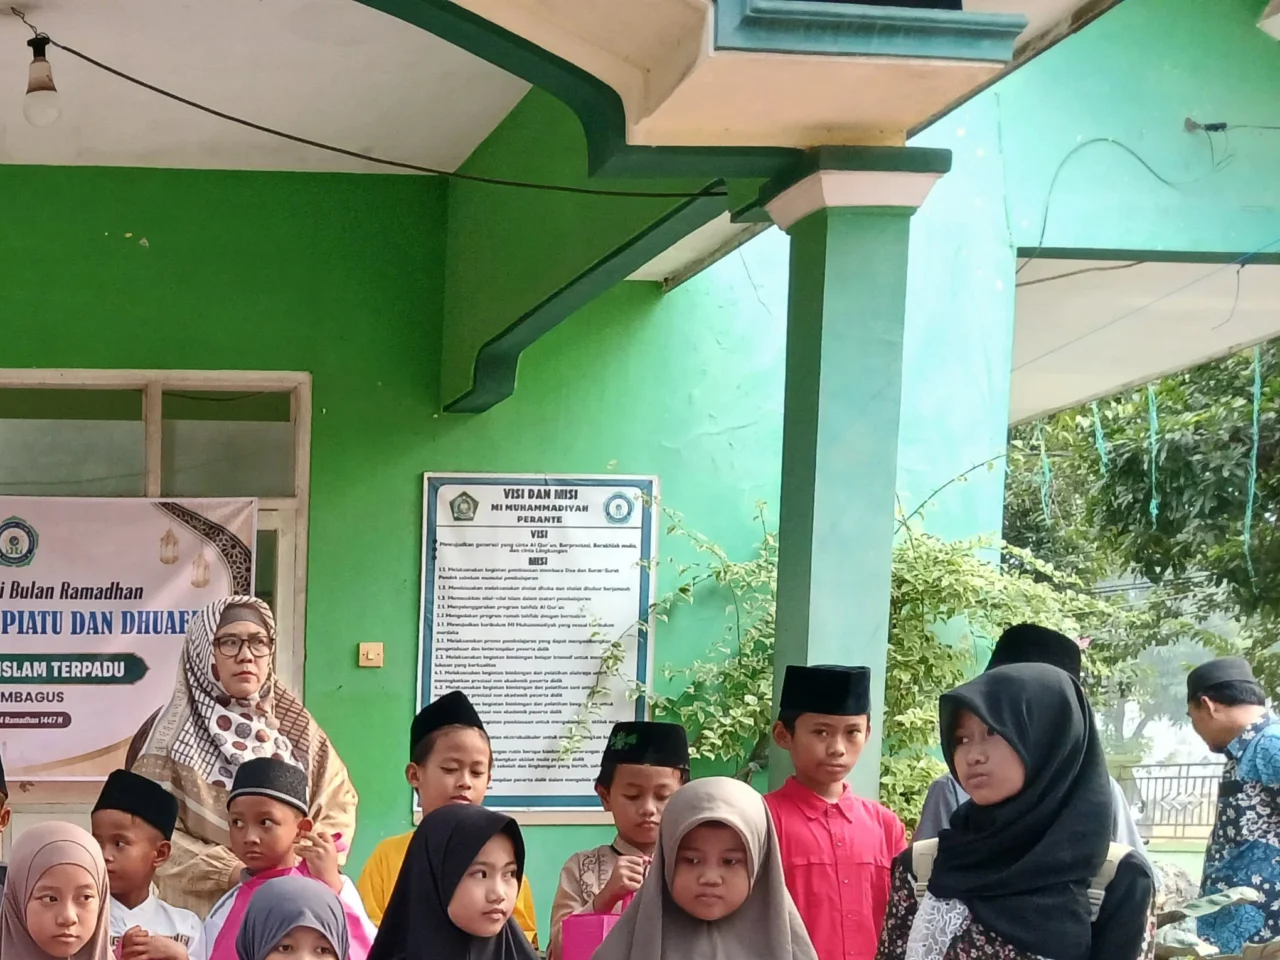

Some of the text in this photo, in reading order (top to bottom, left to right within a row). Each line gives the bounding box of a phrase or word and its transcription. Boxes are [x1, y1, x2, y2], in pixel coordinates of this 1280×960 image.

[503, 489, 579, 500] VISI DAN MISI
[505, 504, 589, 512] MUHAMMADIYAH
[530, 530, 548, 539] VISI
[9, 580, 54, 600] Bulan
[59, 581, 144, 600] Ramadhan
[1, 610, 63, 635] PIATU
[70, 610, 114, 635] DAN
[120, 610, 199, 635] DHUAF
[51, 661, 125, 677] TERPADU
